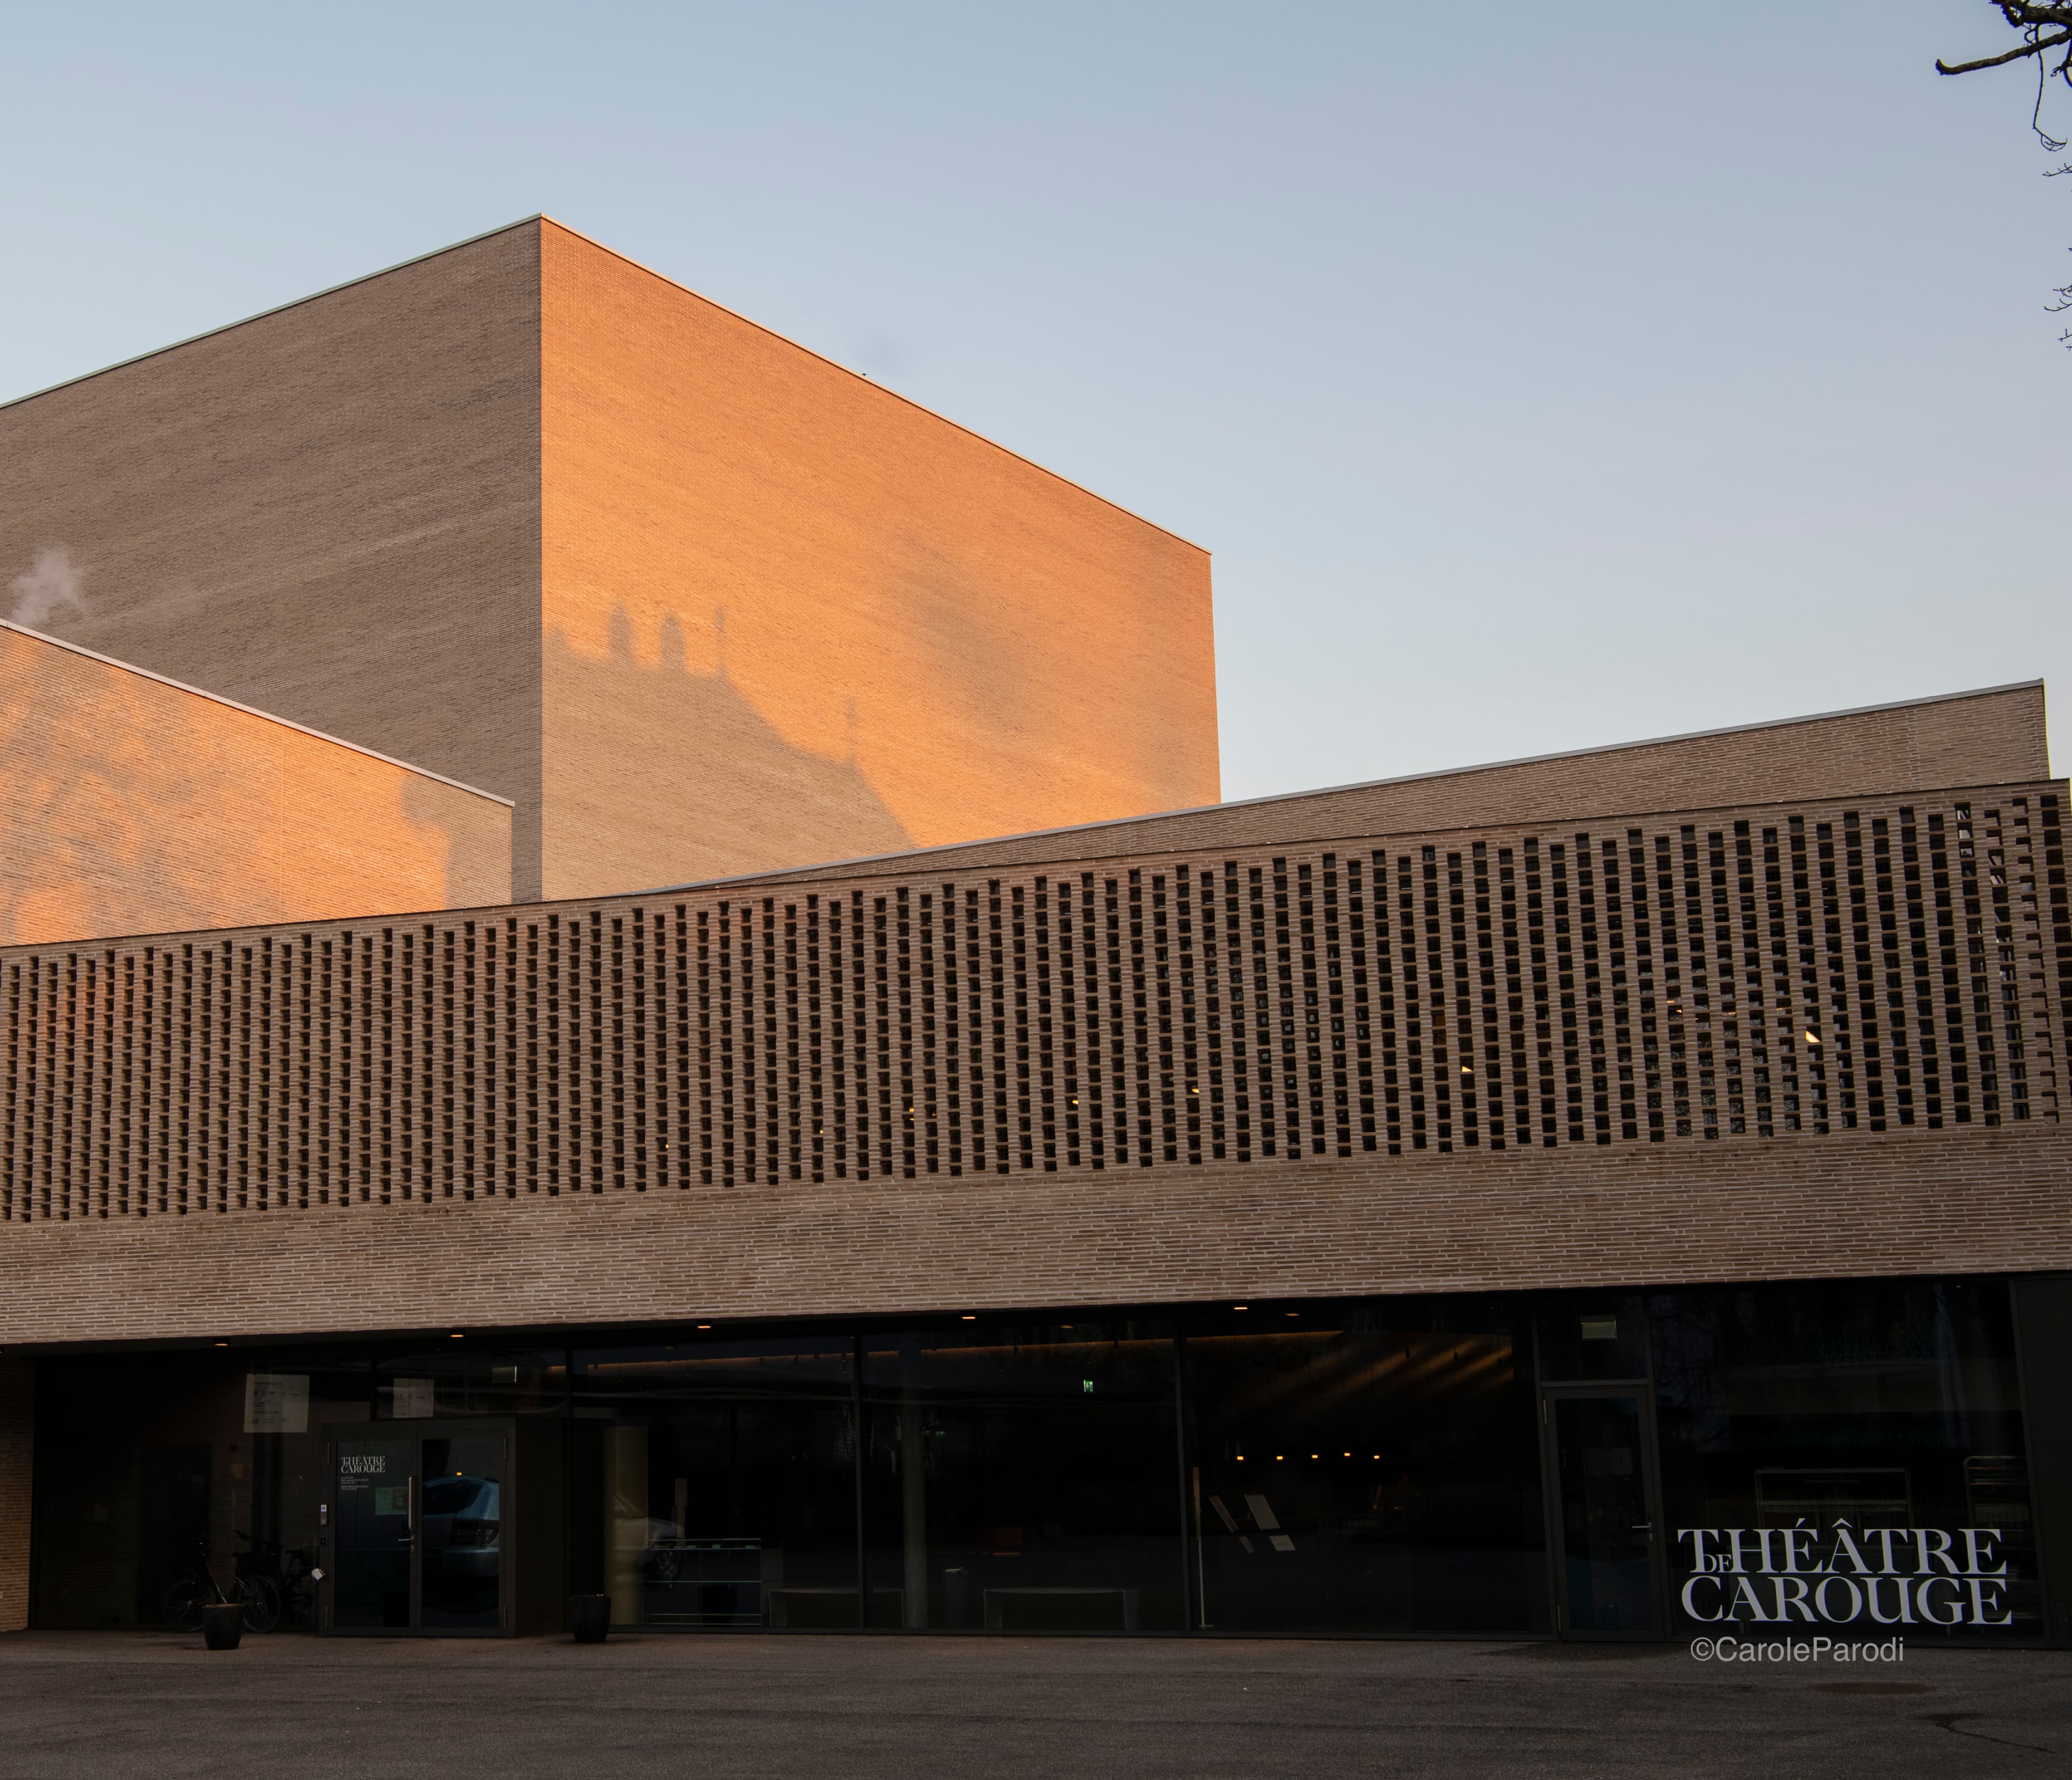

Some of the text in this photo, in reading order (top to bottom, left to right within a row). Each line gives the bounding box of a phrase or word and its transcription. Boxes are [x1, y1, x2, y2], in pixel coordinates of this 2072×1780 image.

[341, 1455, 385, 1464] THÉÂTRE
[341, 1464, 385, 1473] CAROUGE
[1678, 1517, 2008, 1575] THÉÂTRE
[1681, 1576, 2012, 1625] CAROUGE
